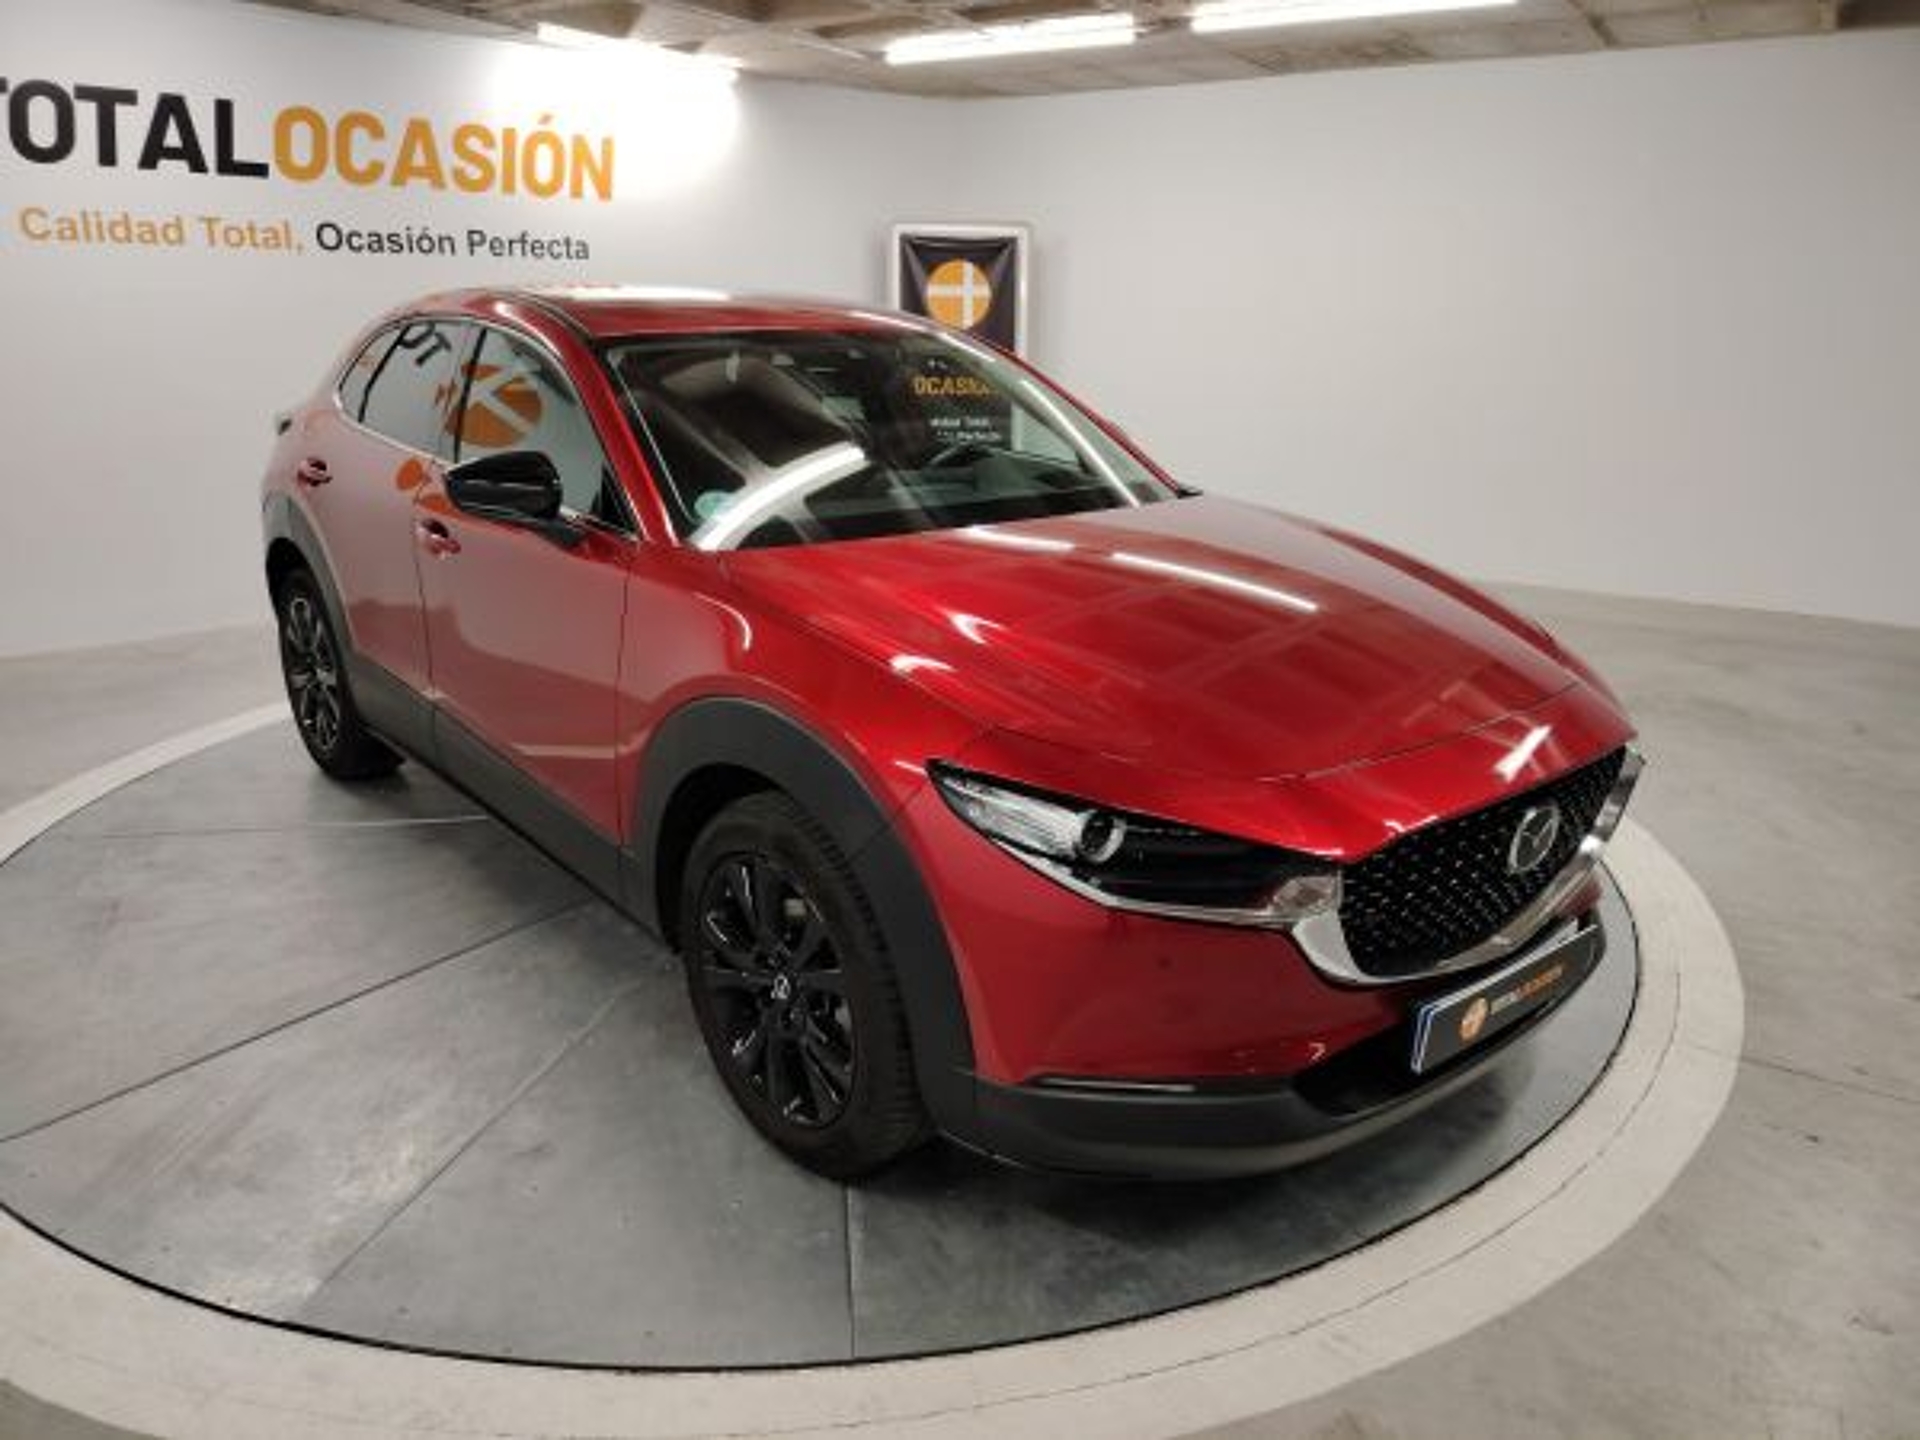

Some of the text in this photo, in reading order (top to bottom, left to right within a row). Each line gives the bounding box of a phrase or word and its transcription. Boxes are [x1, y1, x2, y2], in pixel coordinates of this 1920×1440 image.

[0, 76, 614, 202] OTALOCASIÓN
[19, 207, 184, 245] Calidad
[315, 222, 456, 256] Ocasión
[467, 229, 590, 261] Perfecta
